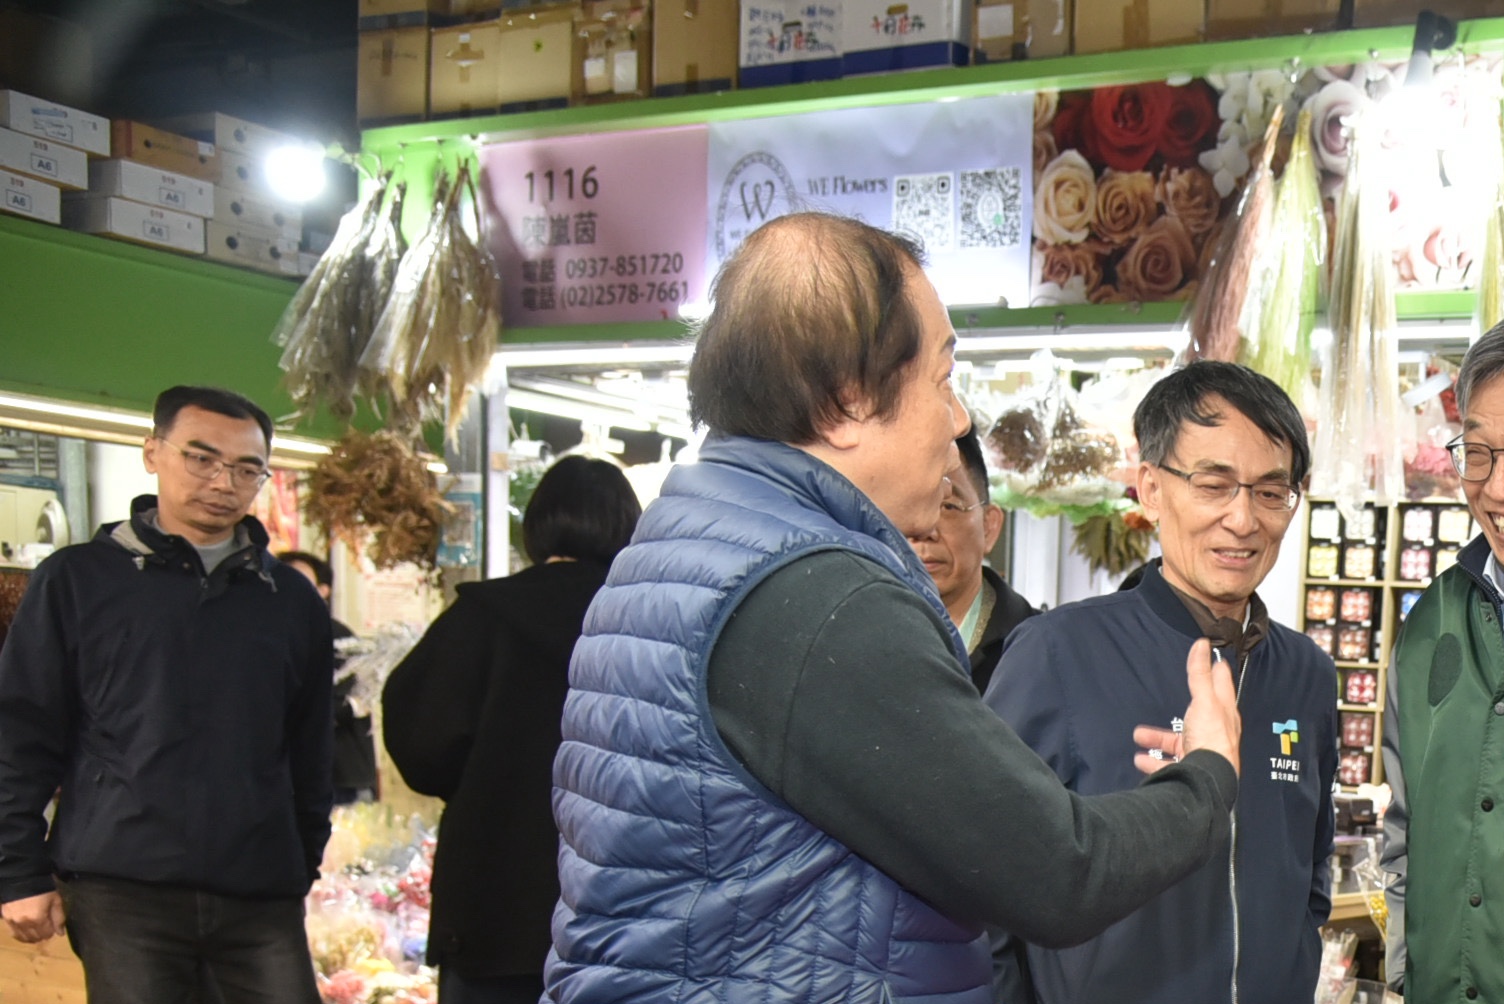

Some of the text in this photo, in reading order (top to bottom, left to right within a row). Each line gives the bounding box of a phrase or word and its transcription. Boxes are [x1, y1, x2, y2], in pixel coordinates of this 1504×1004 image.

[37, 160, 52, 171] A6
[525, 165, 599, 202] 1116
[807, 175, 889, 196] WE Flowers
[12, 195, 26, 206] A6
[165, 192, 179, 203] A6
[522, 212, 598, 246] 陳嵐茵
[522, 252, 684, 284] 電話 0937-851720
[521, 281, 688, 312] 電話 (02)2578-7661
[1270, 757, 1300, 771] TAIPEI
